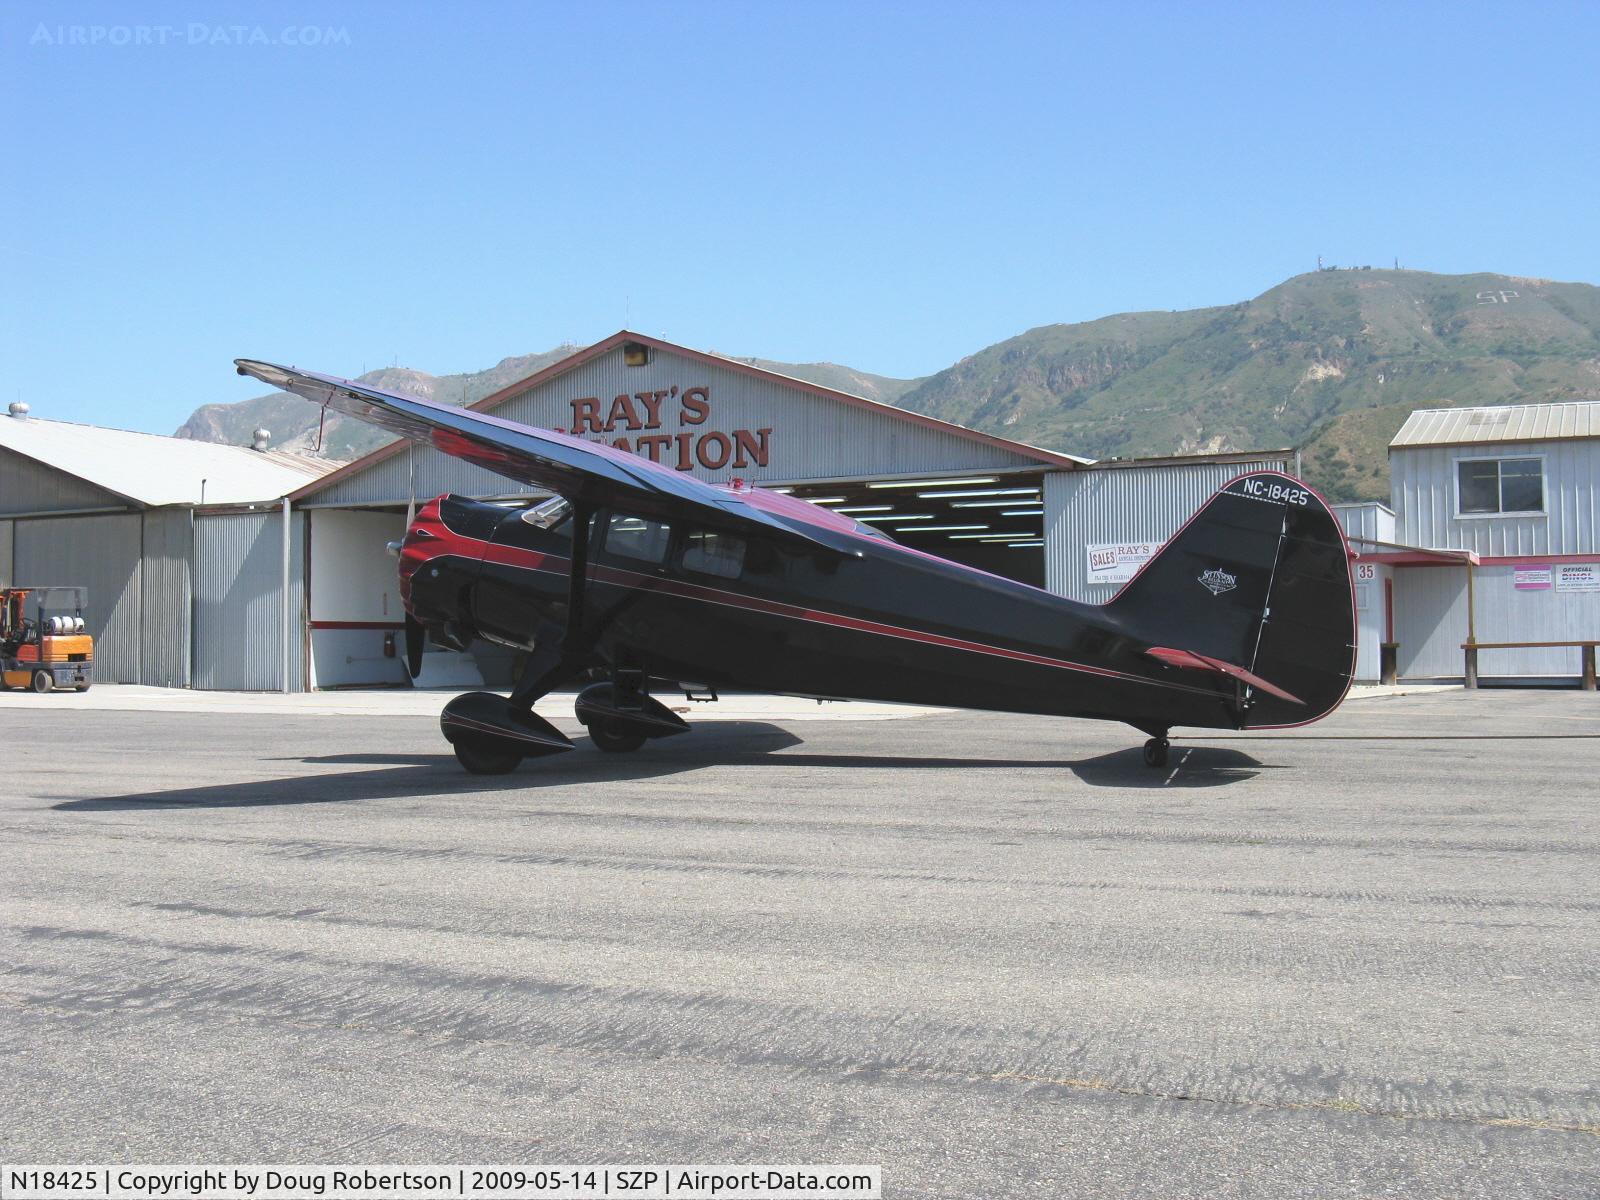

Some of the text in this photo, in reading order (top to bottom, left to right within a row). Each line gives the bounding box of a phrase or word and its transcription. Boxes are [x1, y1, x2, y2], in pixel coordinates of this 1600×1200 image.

[1476, 290, 1520, 304] SP
[570, 386, 710, 434] RAY'S
[1244, 479, 1309, 506] NC-18425
[1118, 544, 1150, 555] RAY'S
[1092, 551, 1115, 567] SALES
[1359, 565, 1374, 579] 35
